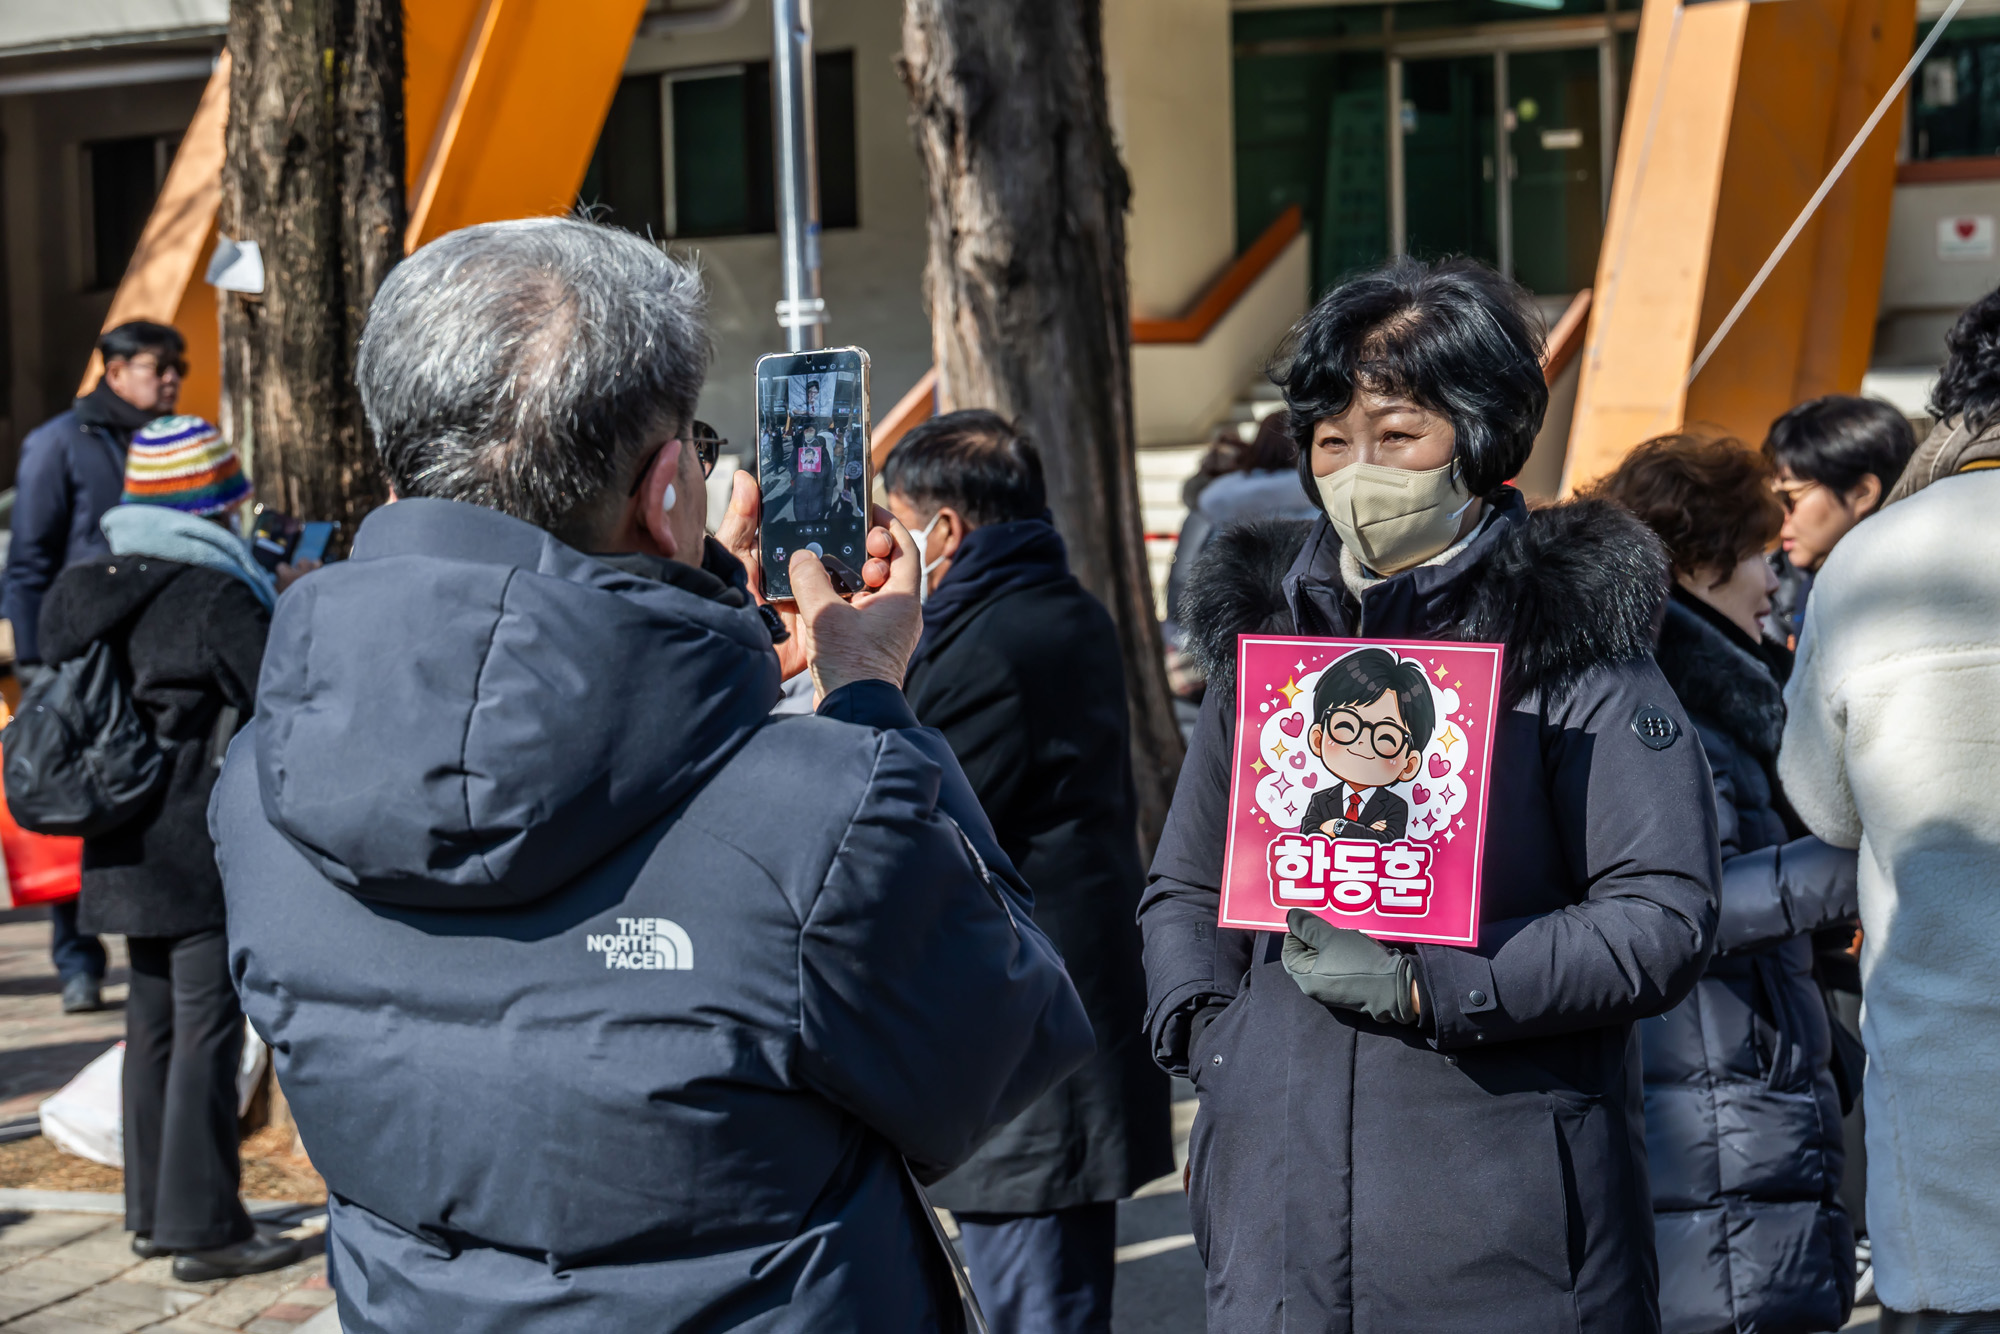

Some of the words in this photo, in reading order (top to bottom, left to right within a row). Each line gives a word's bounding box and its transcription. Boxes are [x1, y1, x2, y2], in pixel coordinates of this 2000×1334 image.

[1274, 839, 1427, 907] 한동훈
[616, 917, 655, 935] THE
[586, 934, 655, 952] NORTH
[605, 951, 655, 970] FACE
